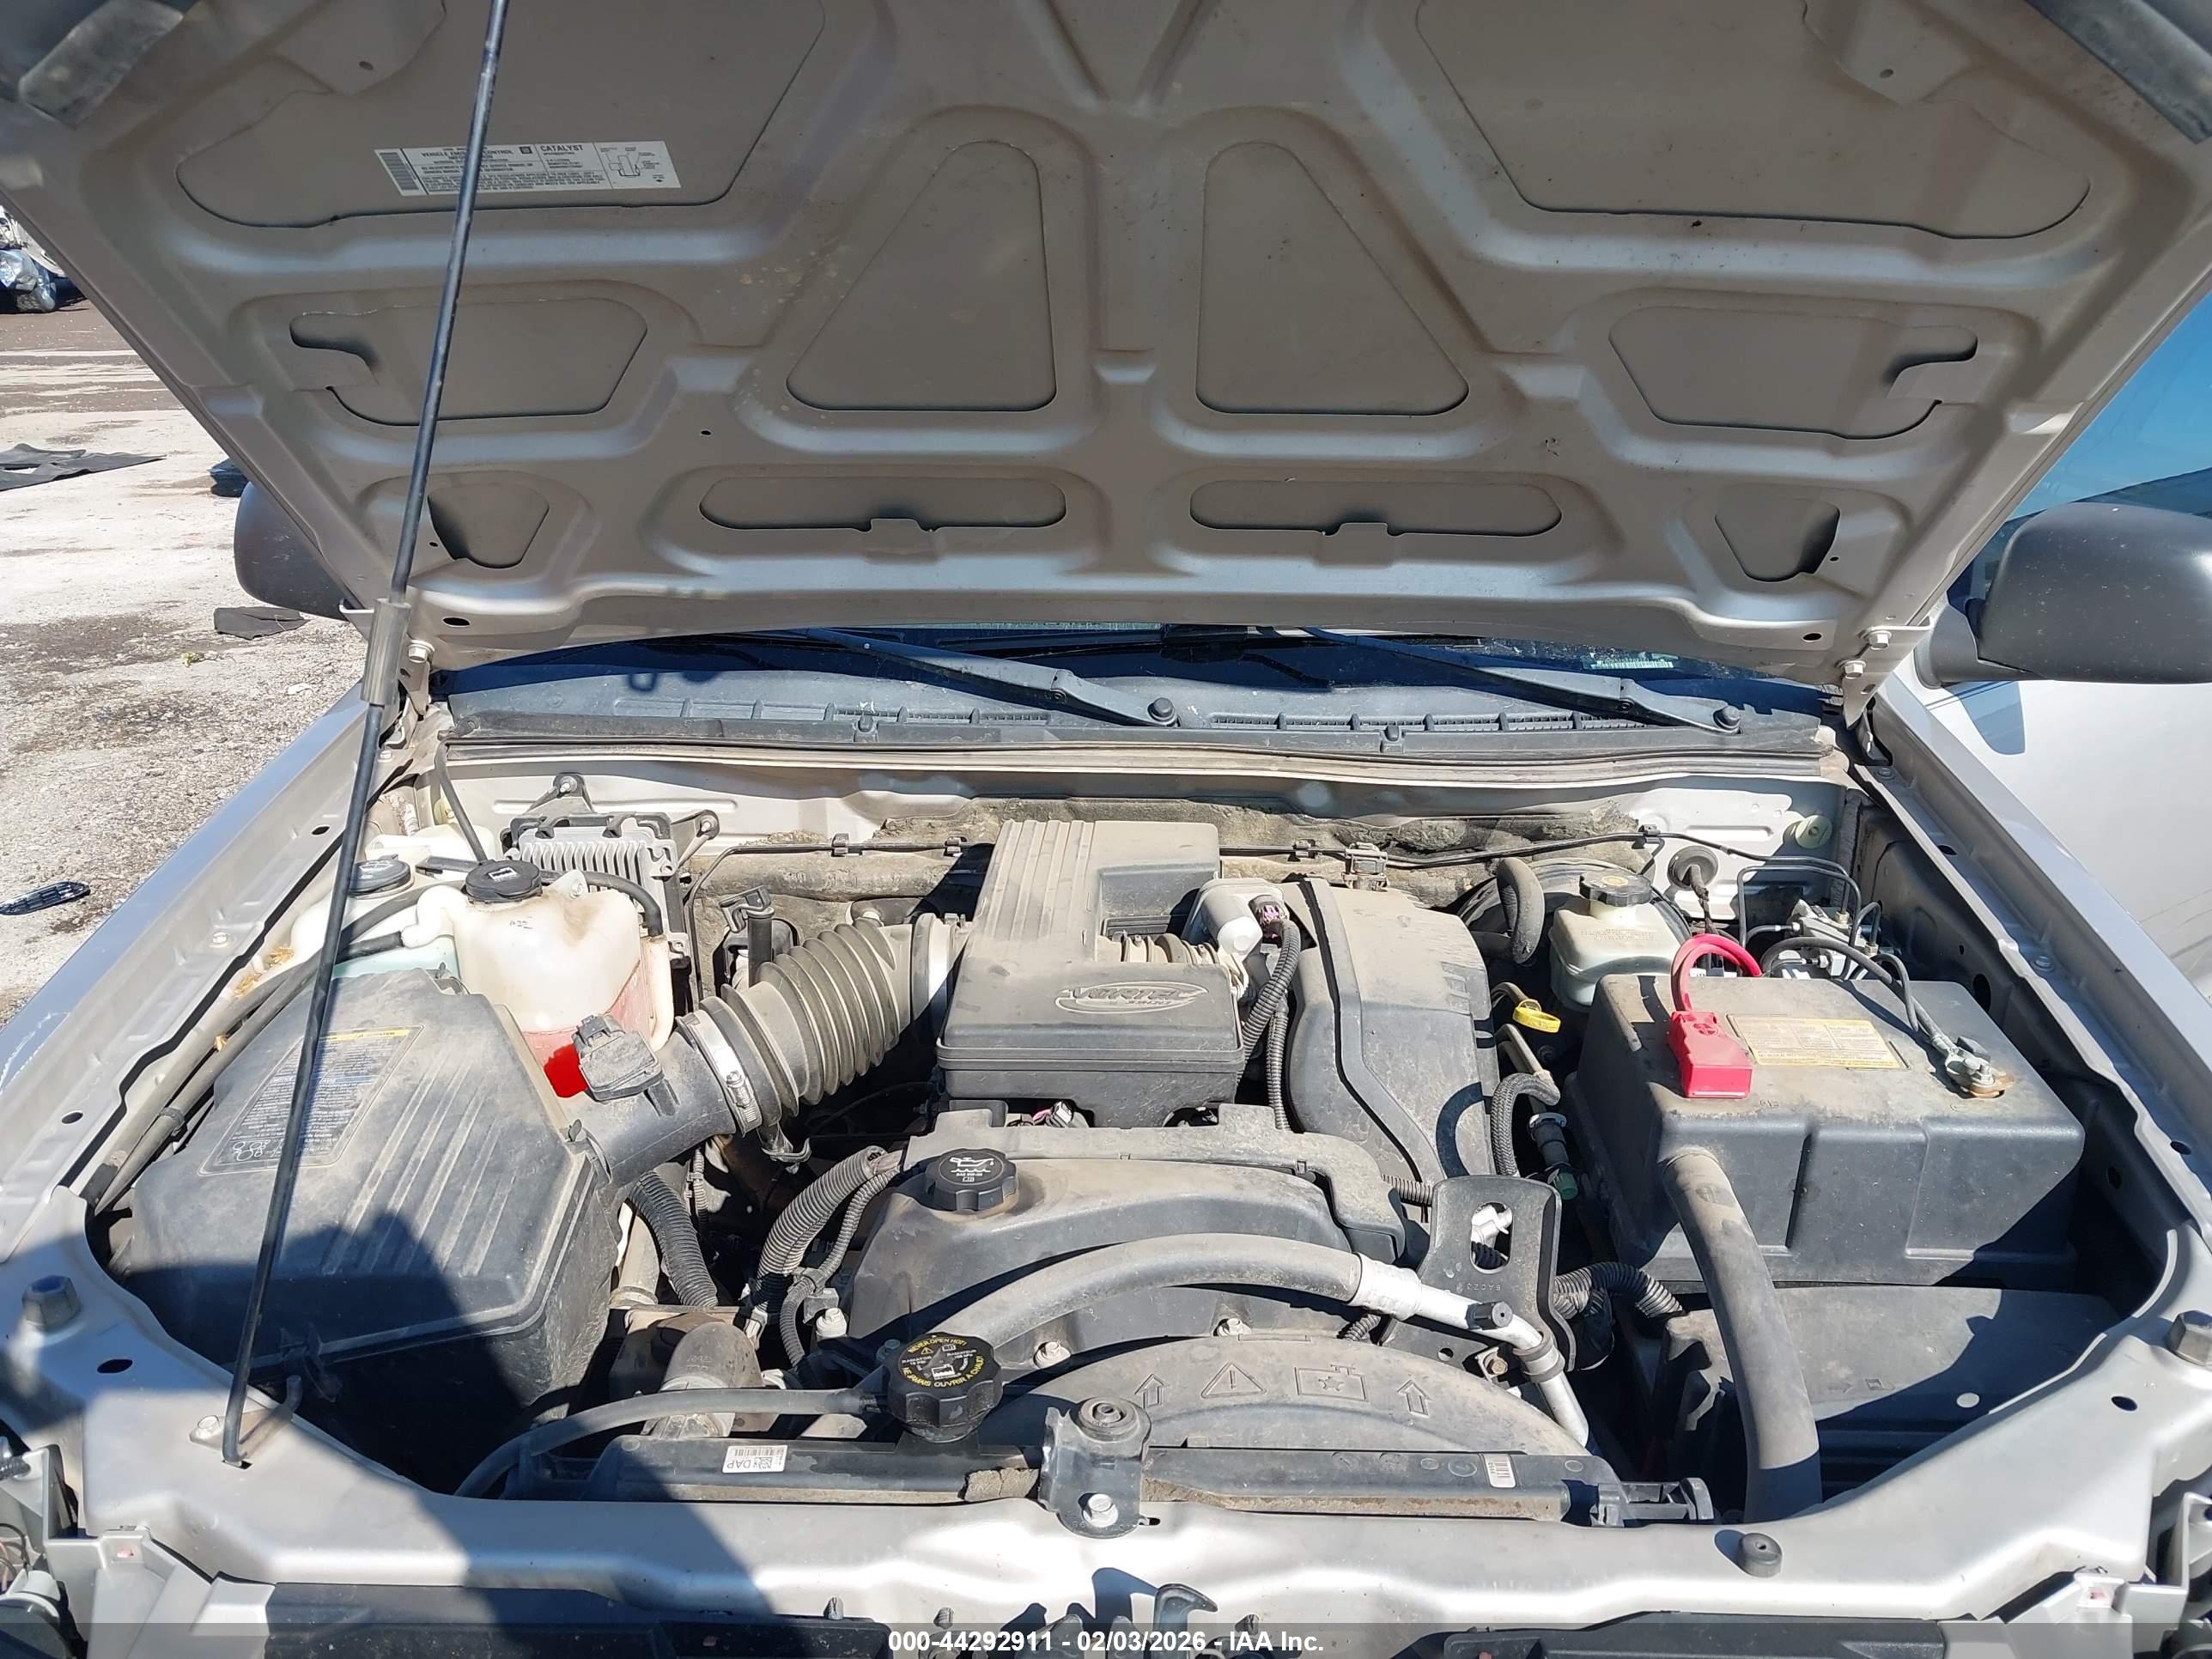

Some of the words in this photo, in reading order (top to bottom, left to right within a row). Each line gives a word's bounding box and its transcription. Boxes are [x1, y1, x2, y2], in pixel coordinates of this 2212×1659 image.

[907, 1340, 930, 1353] NEVER
[933, 1376, 968, 1388] OUVRIR
[726, 1459, 751, 1469] DAP
